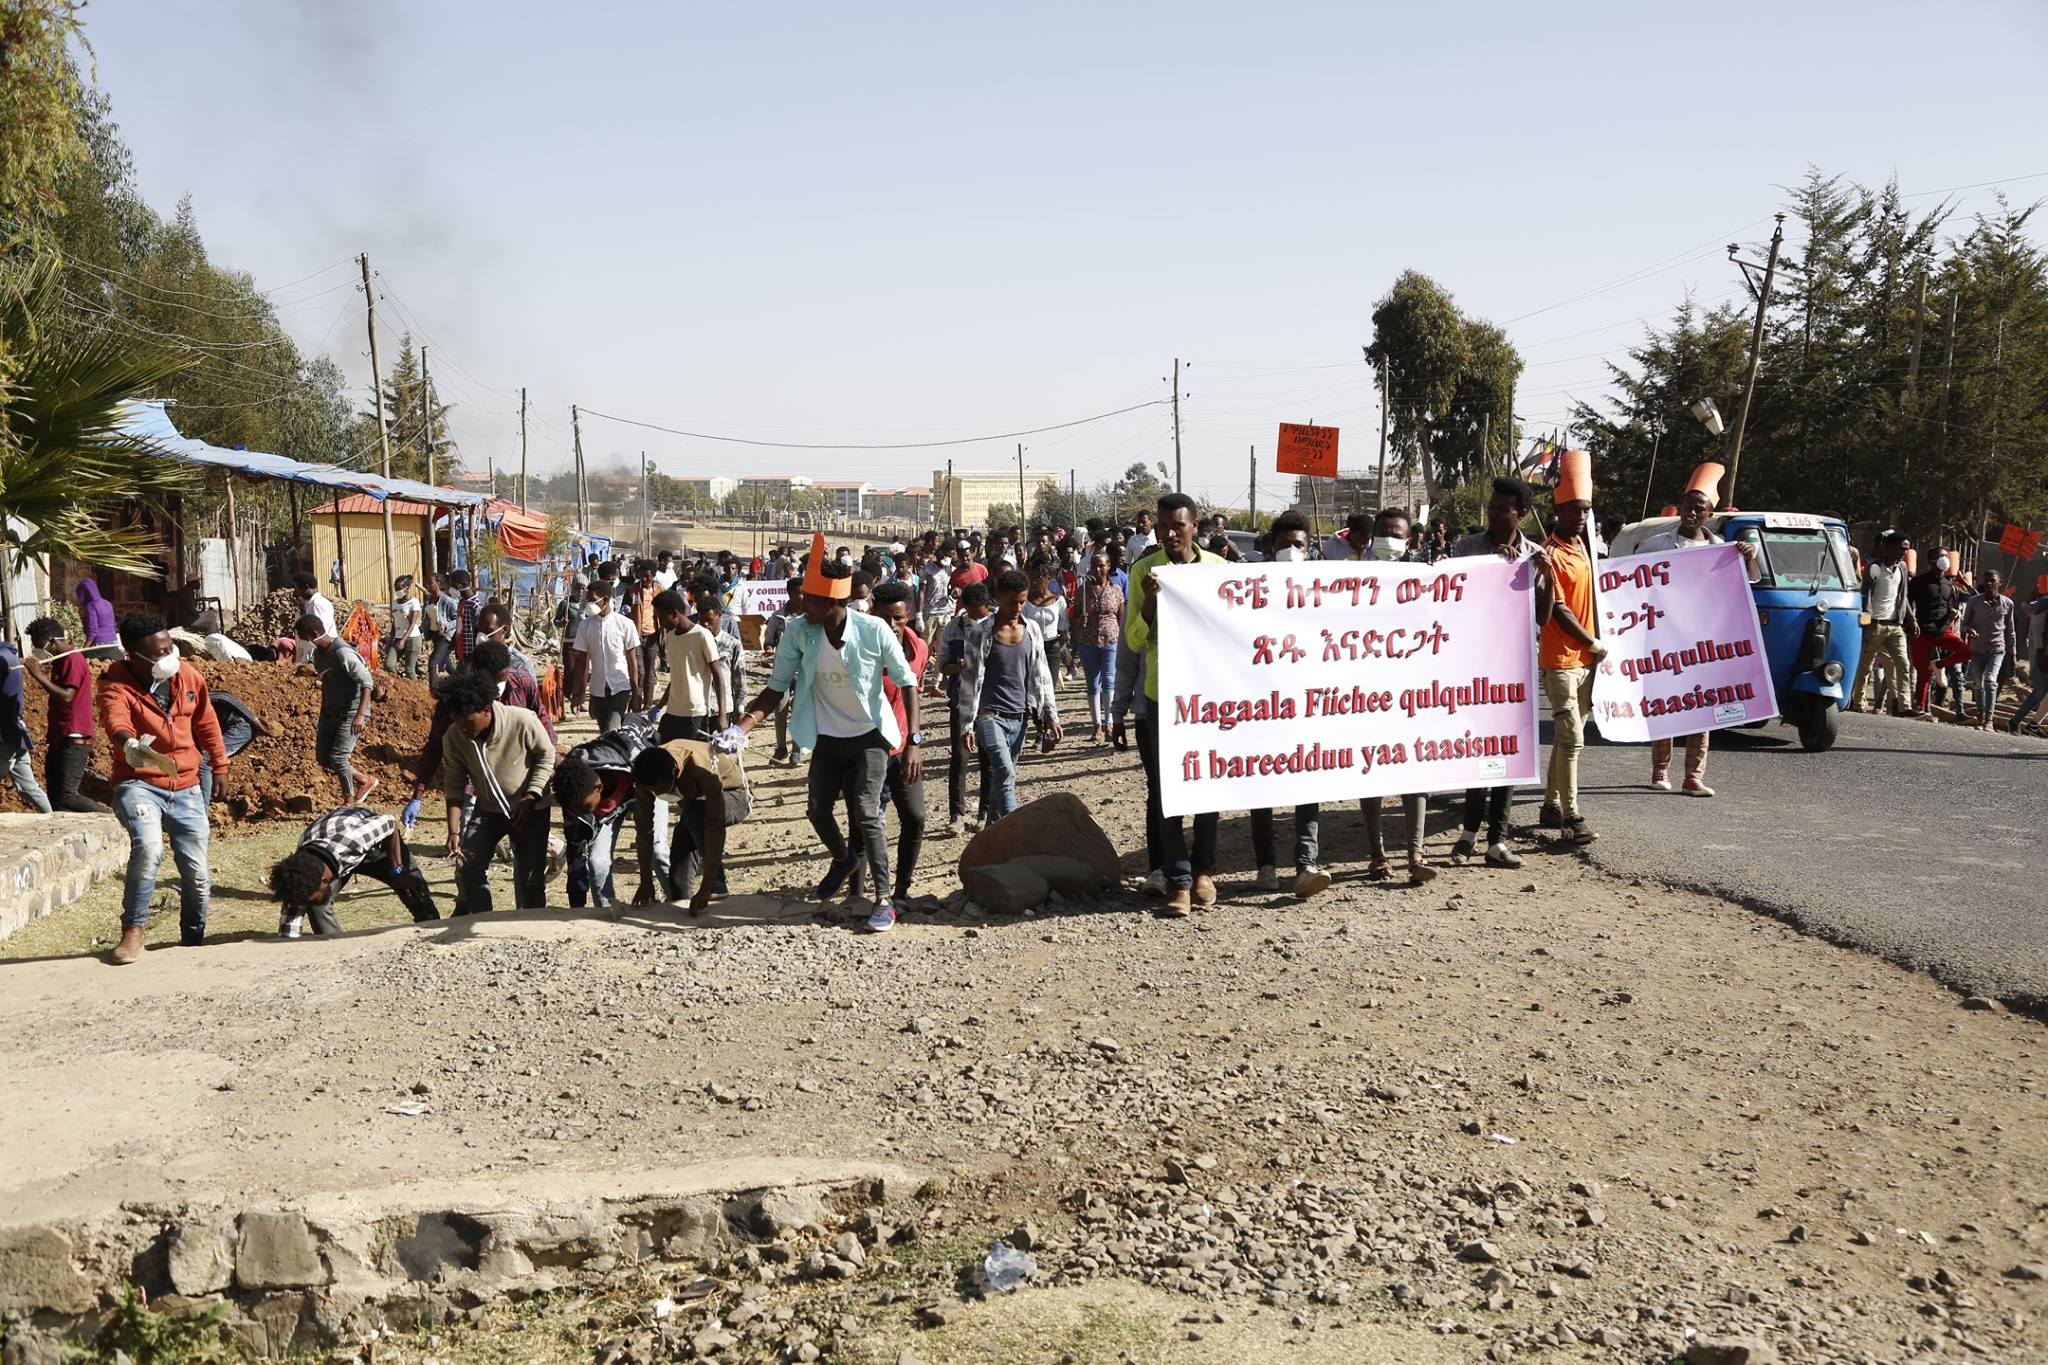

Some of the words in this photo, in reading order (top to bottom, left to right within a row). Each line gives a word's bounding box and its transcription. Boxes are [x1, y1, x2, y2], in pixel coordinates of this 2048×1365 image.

[1285, 576, 1380, 609] ከተማን
[1396, 572, 1467, 604] ውብና
[1252, 634, 1307, 665] ጽዱ
[1320, 620, 1450, 662] እናድርጋት
[1620, 639, 1754, 682] qulqulluu
[1174, 690, 1296, 731] Magaala
[1304, 685, 1393, 718] Fiichee
[1399, 676, 1526, 718] qulqulluu
[1639, 682, 1755, 718] taasisnu
[1182, 751, 1202, 782] fi
[1209, 743, 1354, 779] bareedduu
[1361, 740, 1407, 774] yaa
[1413, 730, 1519, 762] taasisnu
